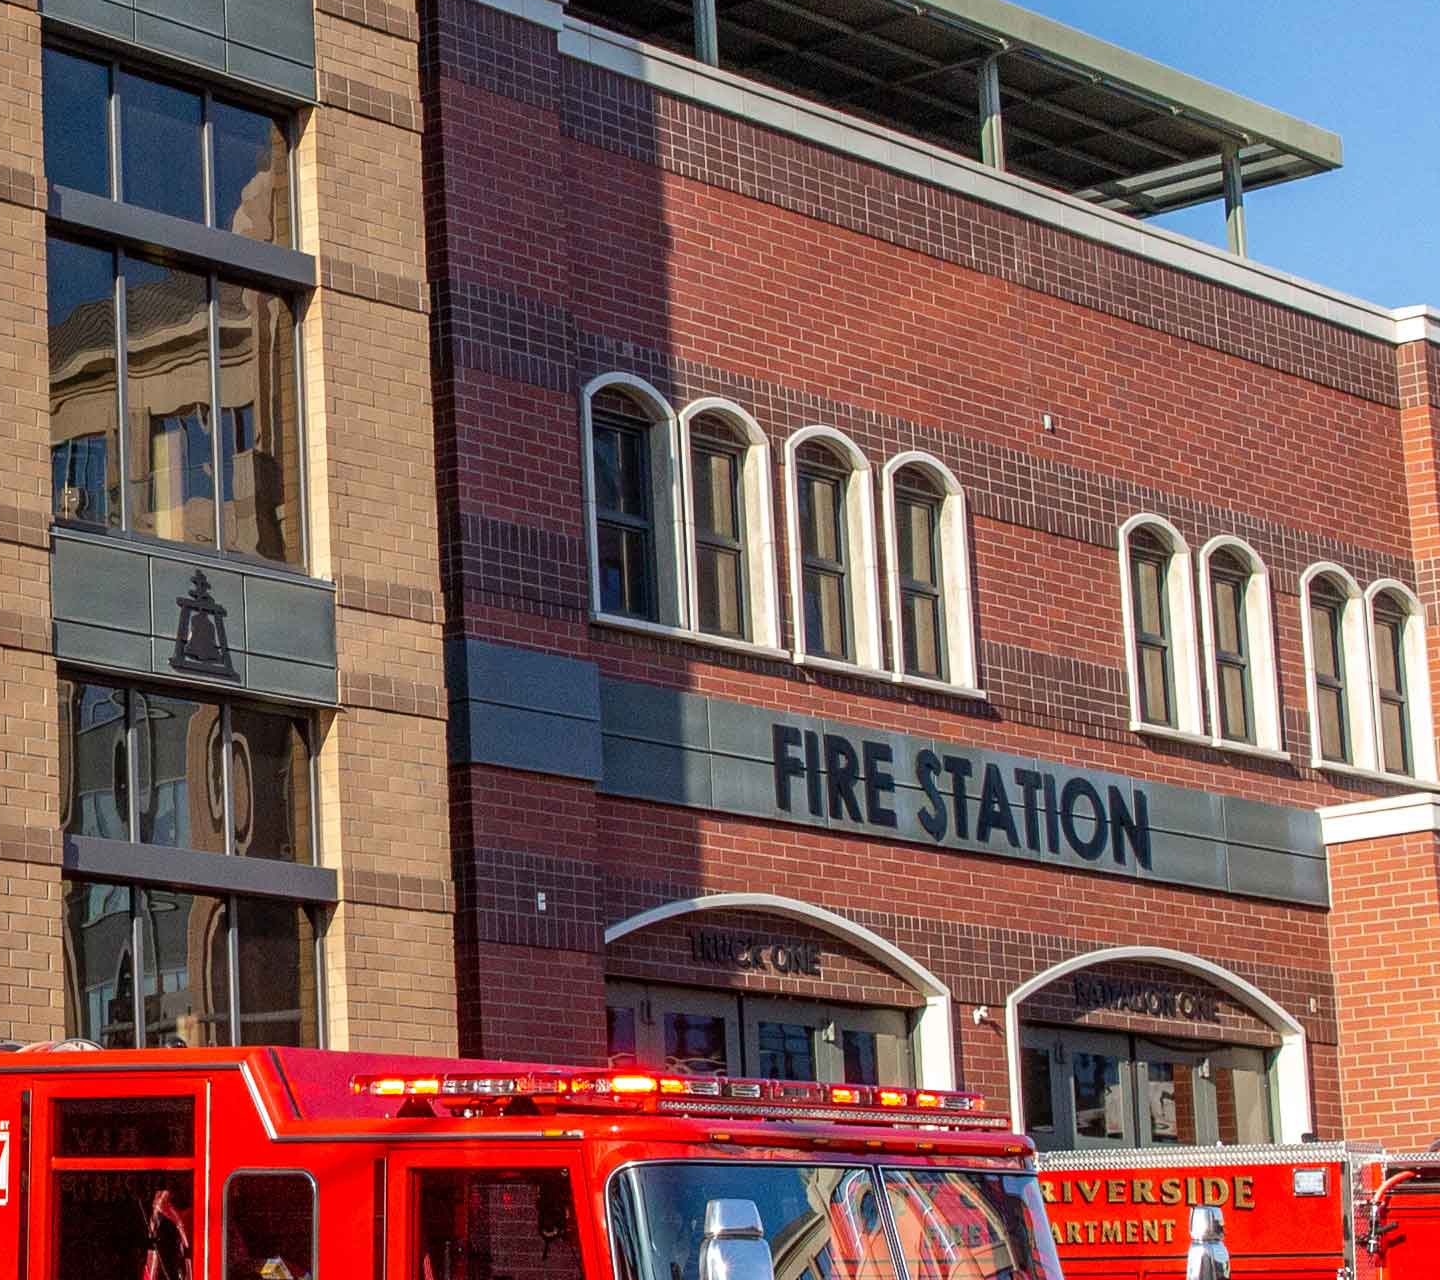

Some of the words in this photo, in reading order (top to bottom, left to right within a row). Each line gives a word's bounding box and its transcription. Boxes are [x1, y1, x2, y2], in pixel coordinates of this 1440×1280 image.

[772, 723, 897, 828] FIRE
[917, 748, 1152, 871] STATION
[691, 926, 766, 970] TRUCK
[772, 943, 821, 976] ONE
[0, 1120, 10, 1130] BY
[1040, 1175, 1255, 1209] RIVERSIDE
[1051, 1219, 1176, 1245] ARTMENT
